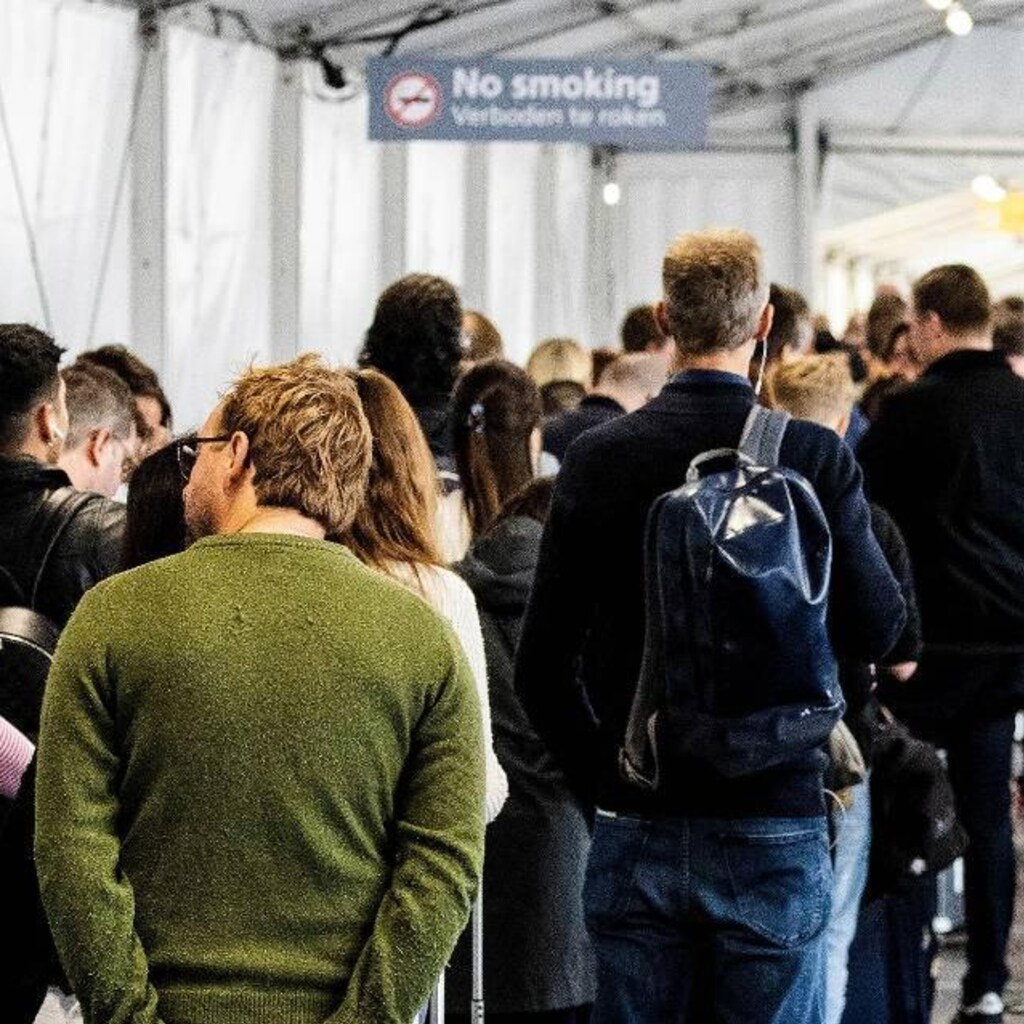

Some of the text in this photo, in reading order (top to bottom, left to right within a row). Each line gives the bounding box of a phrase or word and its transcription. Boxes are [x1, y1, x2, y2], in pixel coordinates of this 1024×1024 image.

[452, 66, 660, 108] No smoking
[452, 105, 666, 127] Verboden te roken
